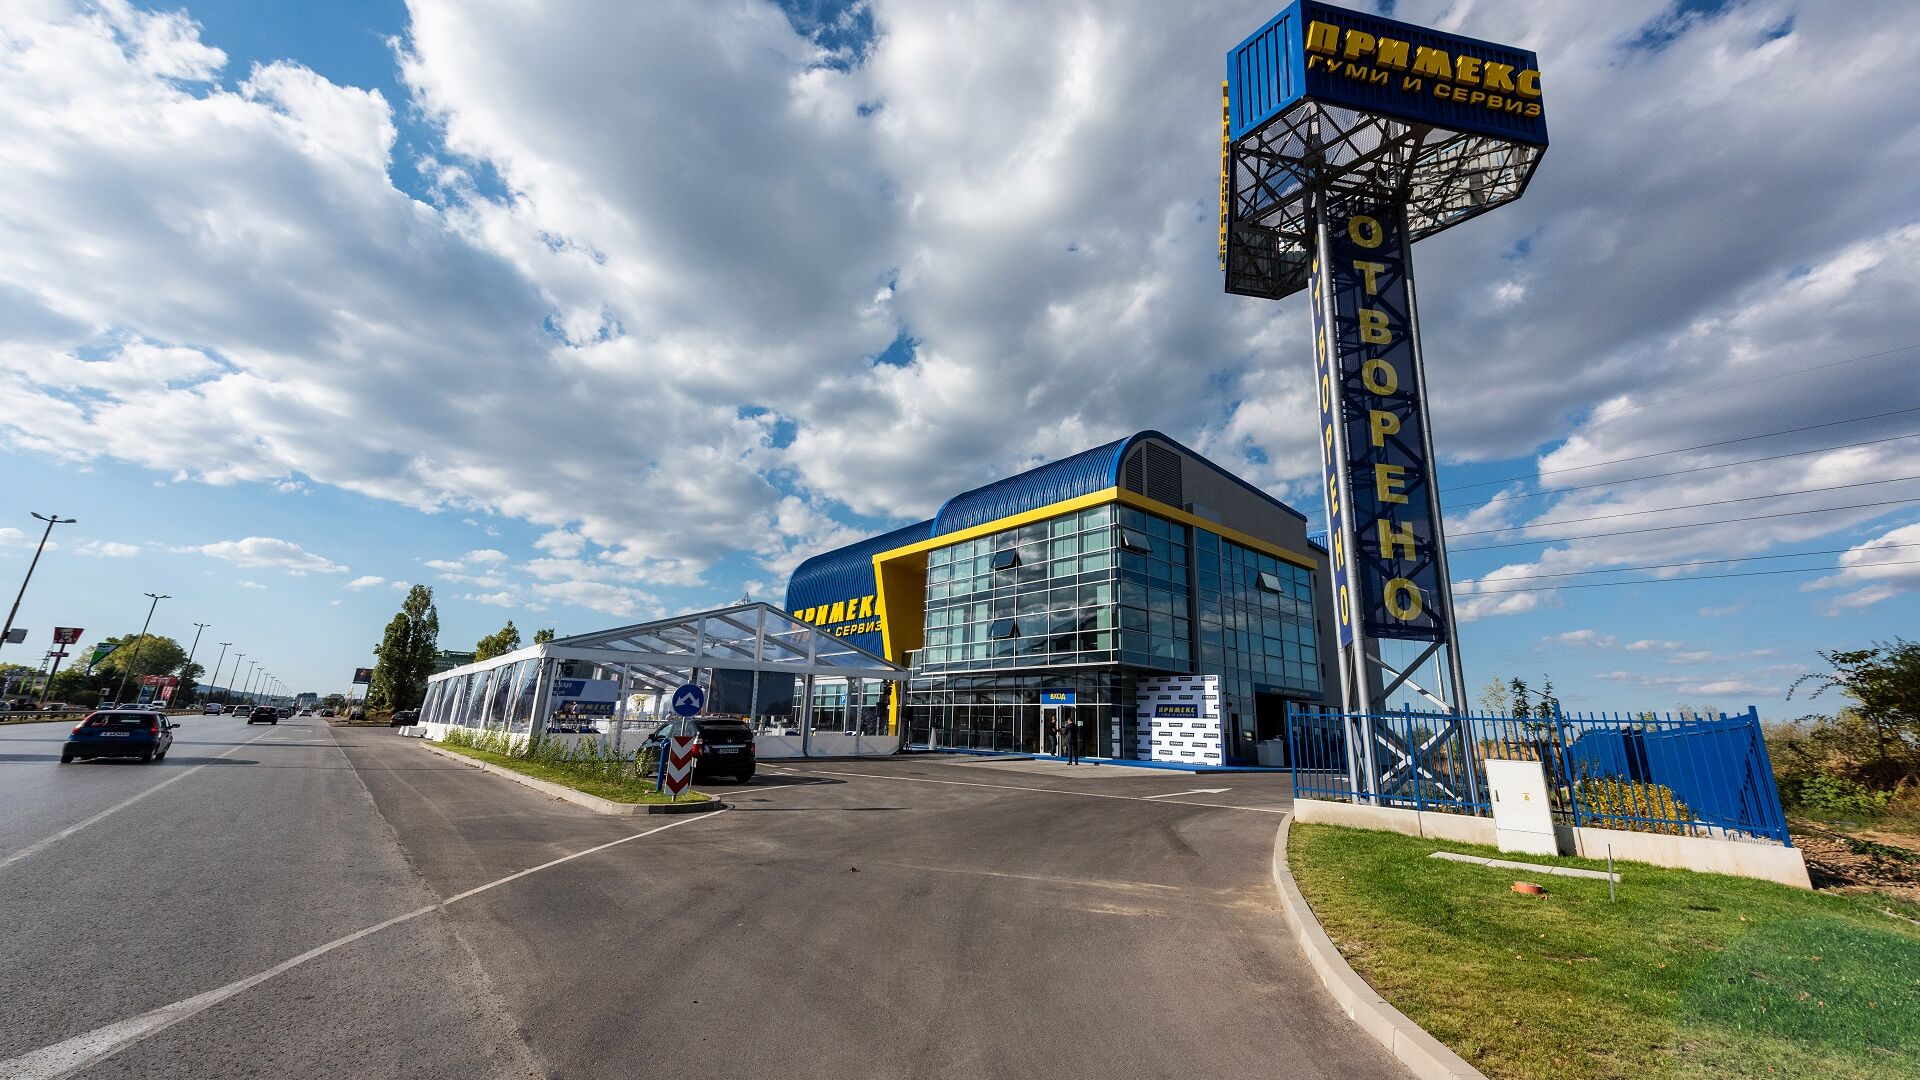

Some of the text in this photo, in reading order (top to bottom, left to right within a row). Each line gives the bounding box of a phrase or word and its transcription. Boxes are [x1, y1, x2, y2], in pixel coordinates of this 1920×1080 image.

[1306, 20, 1541, 98] ПРИМЕКС
[1307, 55, 1541, 117] ГУМИ И СЕРВИЗ
[1348, 215, 1423, 621] ОТВОРЕНО
[835, 620, 882, 637] СЕРВИЗ
[1050, 693, 1066, 701] ВХОД
[1158, 706, 1195, 714] ПРИМЕКС
